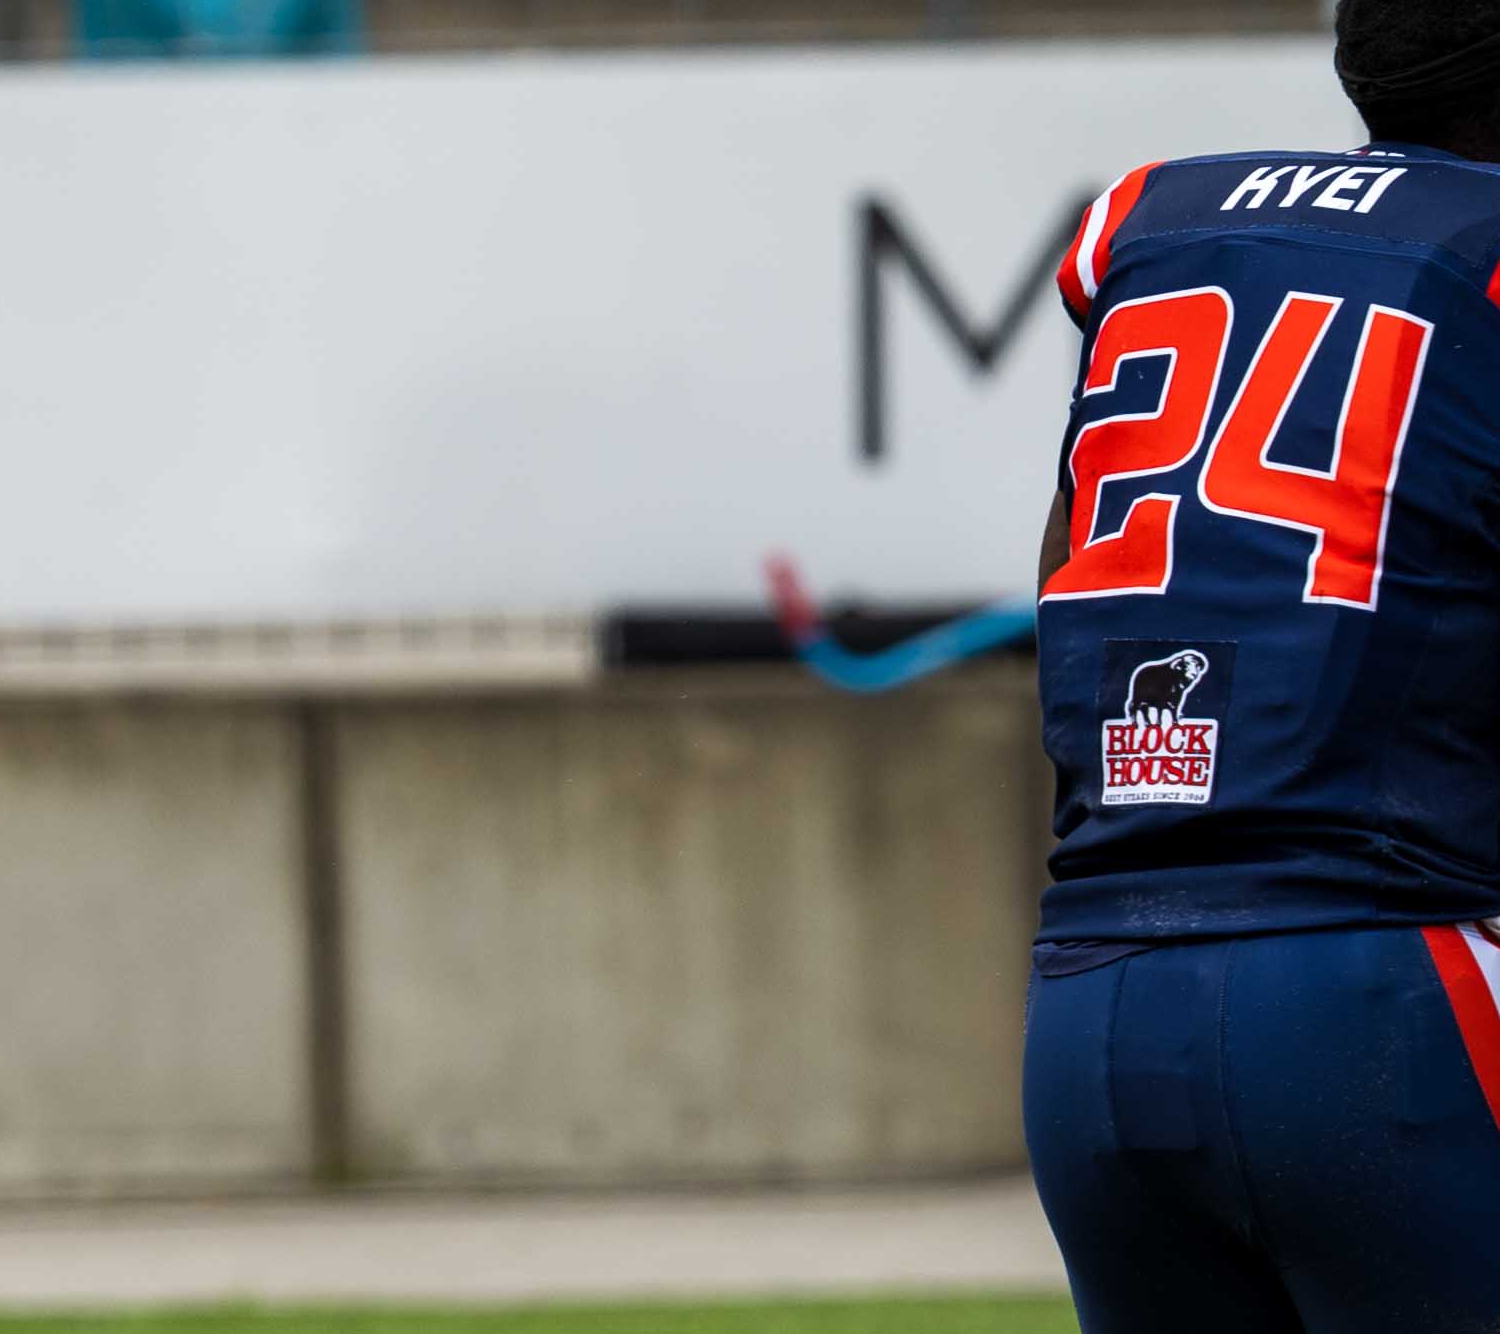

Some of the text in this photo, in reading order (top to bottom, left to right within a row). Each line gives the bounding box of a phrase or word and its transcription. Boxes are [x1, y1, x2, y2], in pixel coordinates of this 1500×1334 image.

[1220, 164, 1408, 214] KYEI
[1037, 284, 1436, 613] 24
[1105, 724, 1213, 756] BLOCK
[1105, 756, 1210, 788] HOUSE
